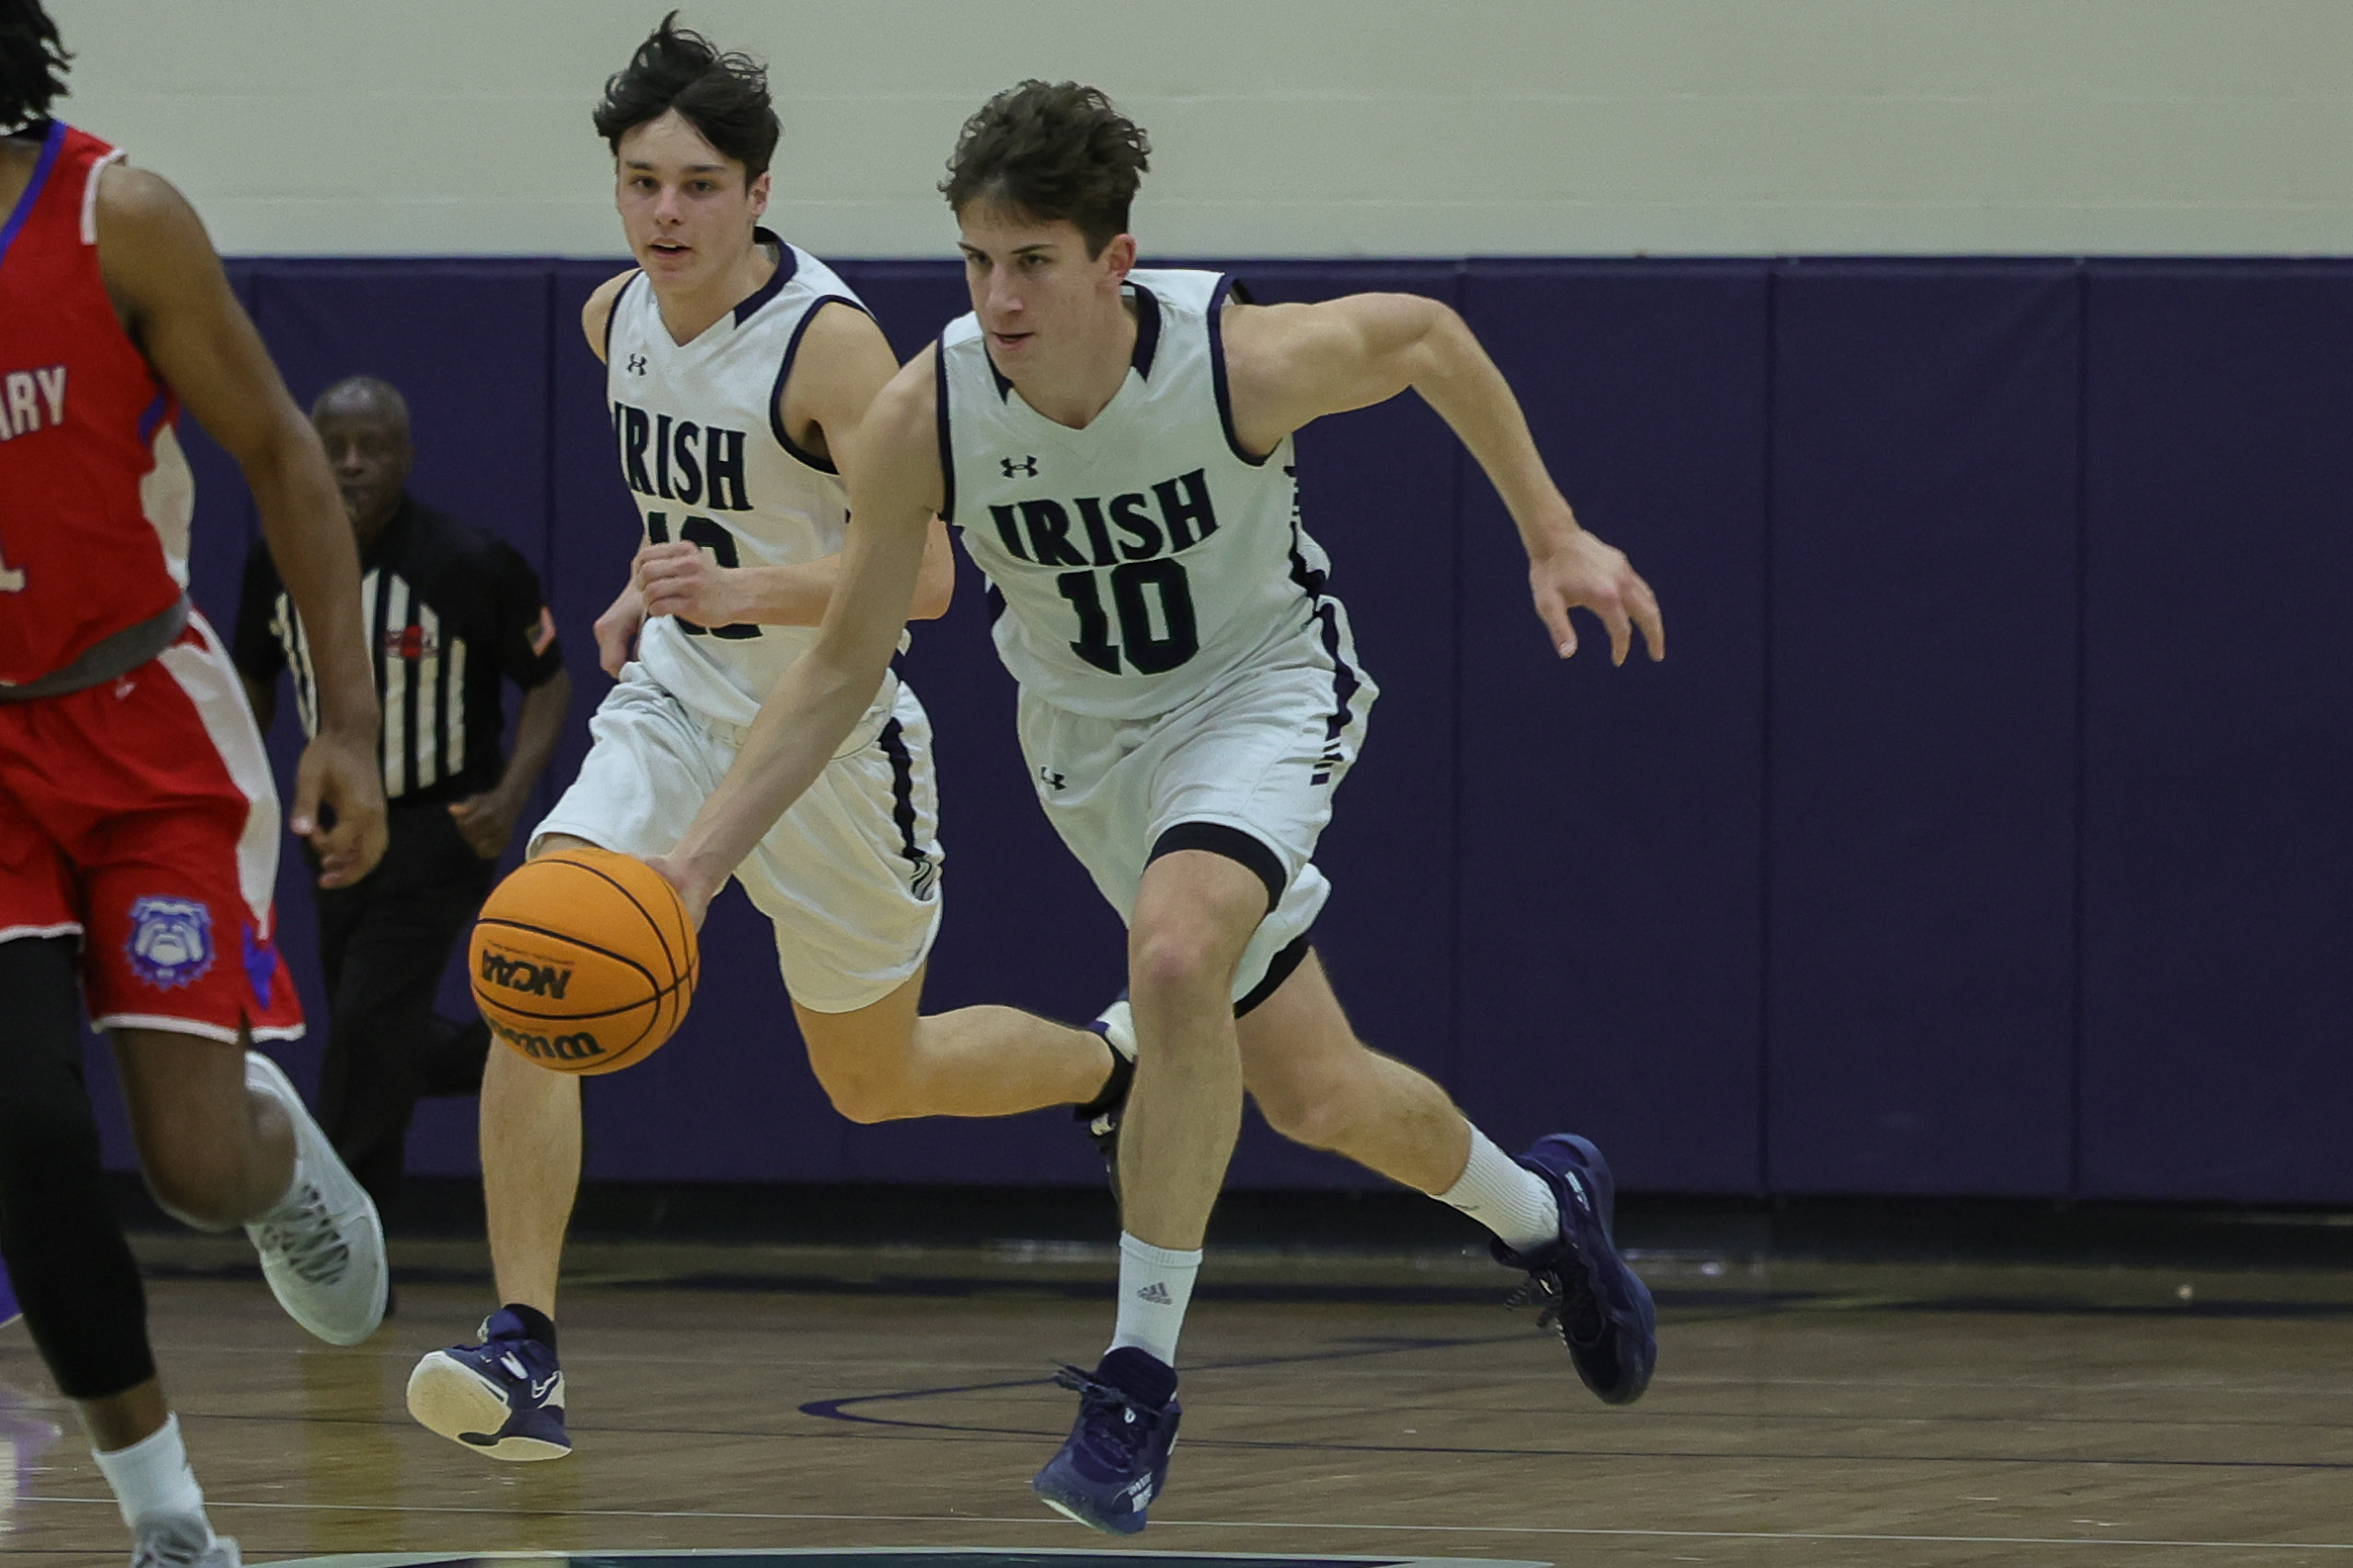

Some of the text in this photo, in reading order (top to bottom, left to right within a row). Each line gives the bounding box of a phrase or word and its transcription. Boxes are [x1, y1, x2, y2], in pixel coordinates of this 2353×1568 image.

[988, 467, 1221, 567] IRISH
[1056, 557, 1200, 677] 10
[482, 950, 573, 1000] NCAA
